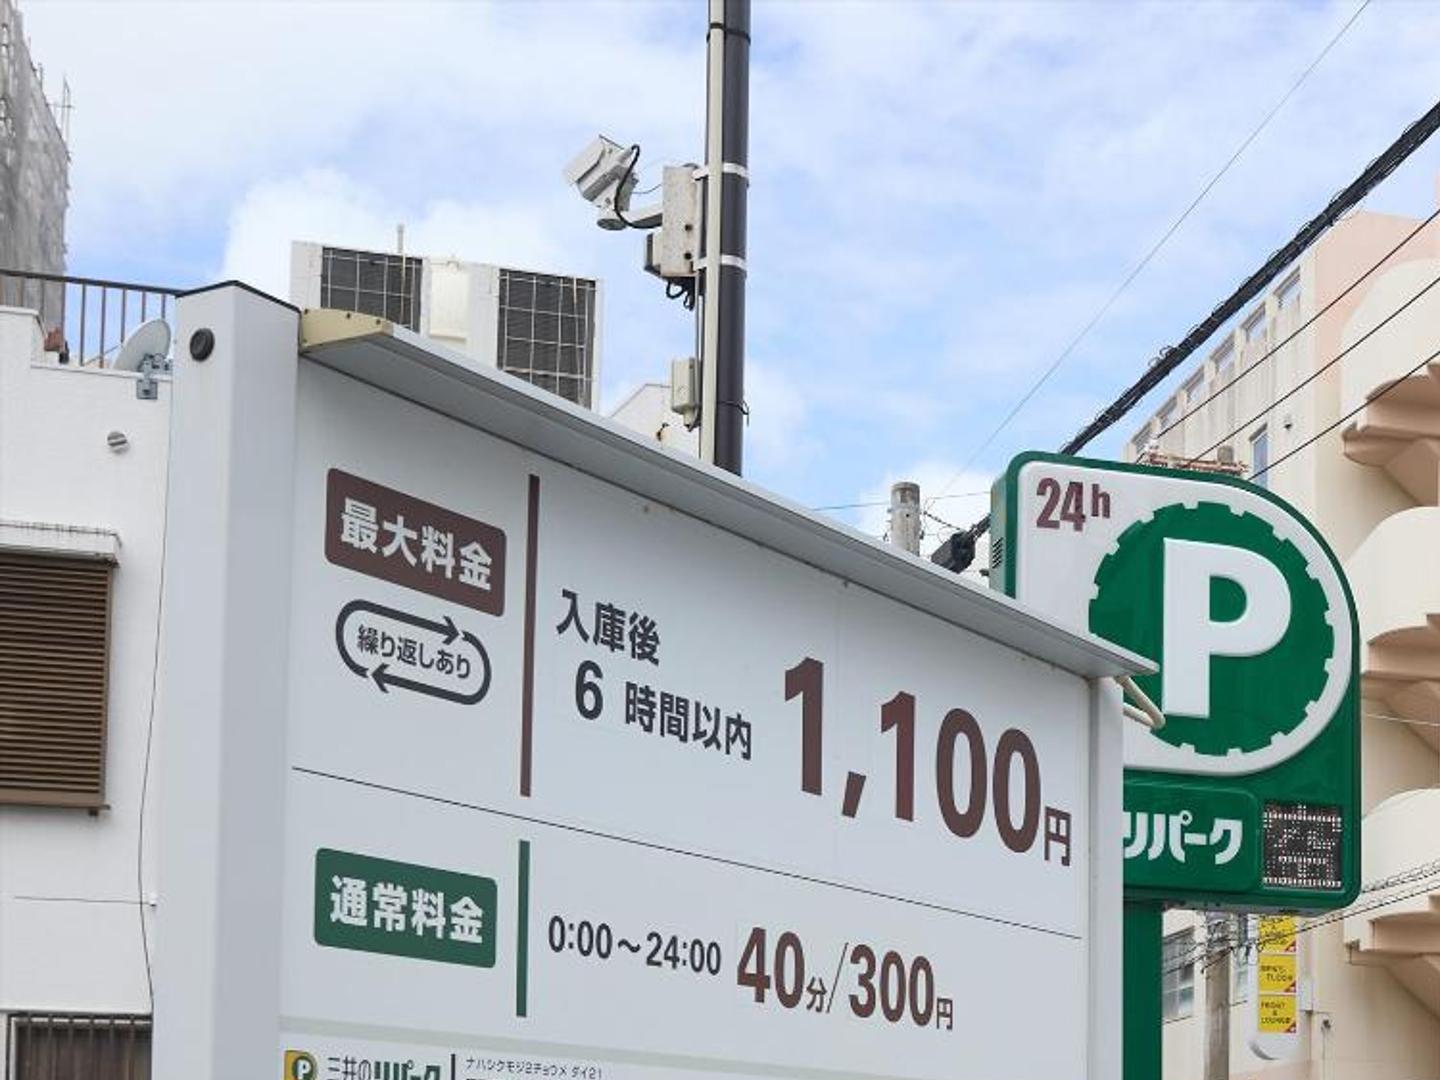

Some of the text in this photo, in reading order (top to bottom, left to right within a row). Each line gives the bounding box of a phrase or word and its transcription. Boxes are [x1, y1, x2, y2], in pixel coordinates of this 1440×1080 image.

[339, 496, 494, 592] 最大料金
[1035, 477, 1111, 532] 24h
[356, 624, 472, 681] 繰り返しあり
[556, 588, 661, 667] 入庫後
[1162, 536, 1292, 719] P
[574, 659, 753, 762] 6 時間以内
[784, 655, 1072, 868] 1,100円
[1123, 810, 1243, 866] リパーク
[1262, 804, 1343, 889] 空
[329, 875, 485, 944] 通常料金
